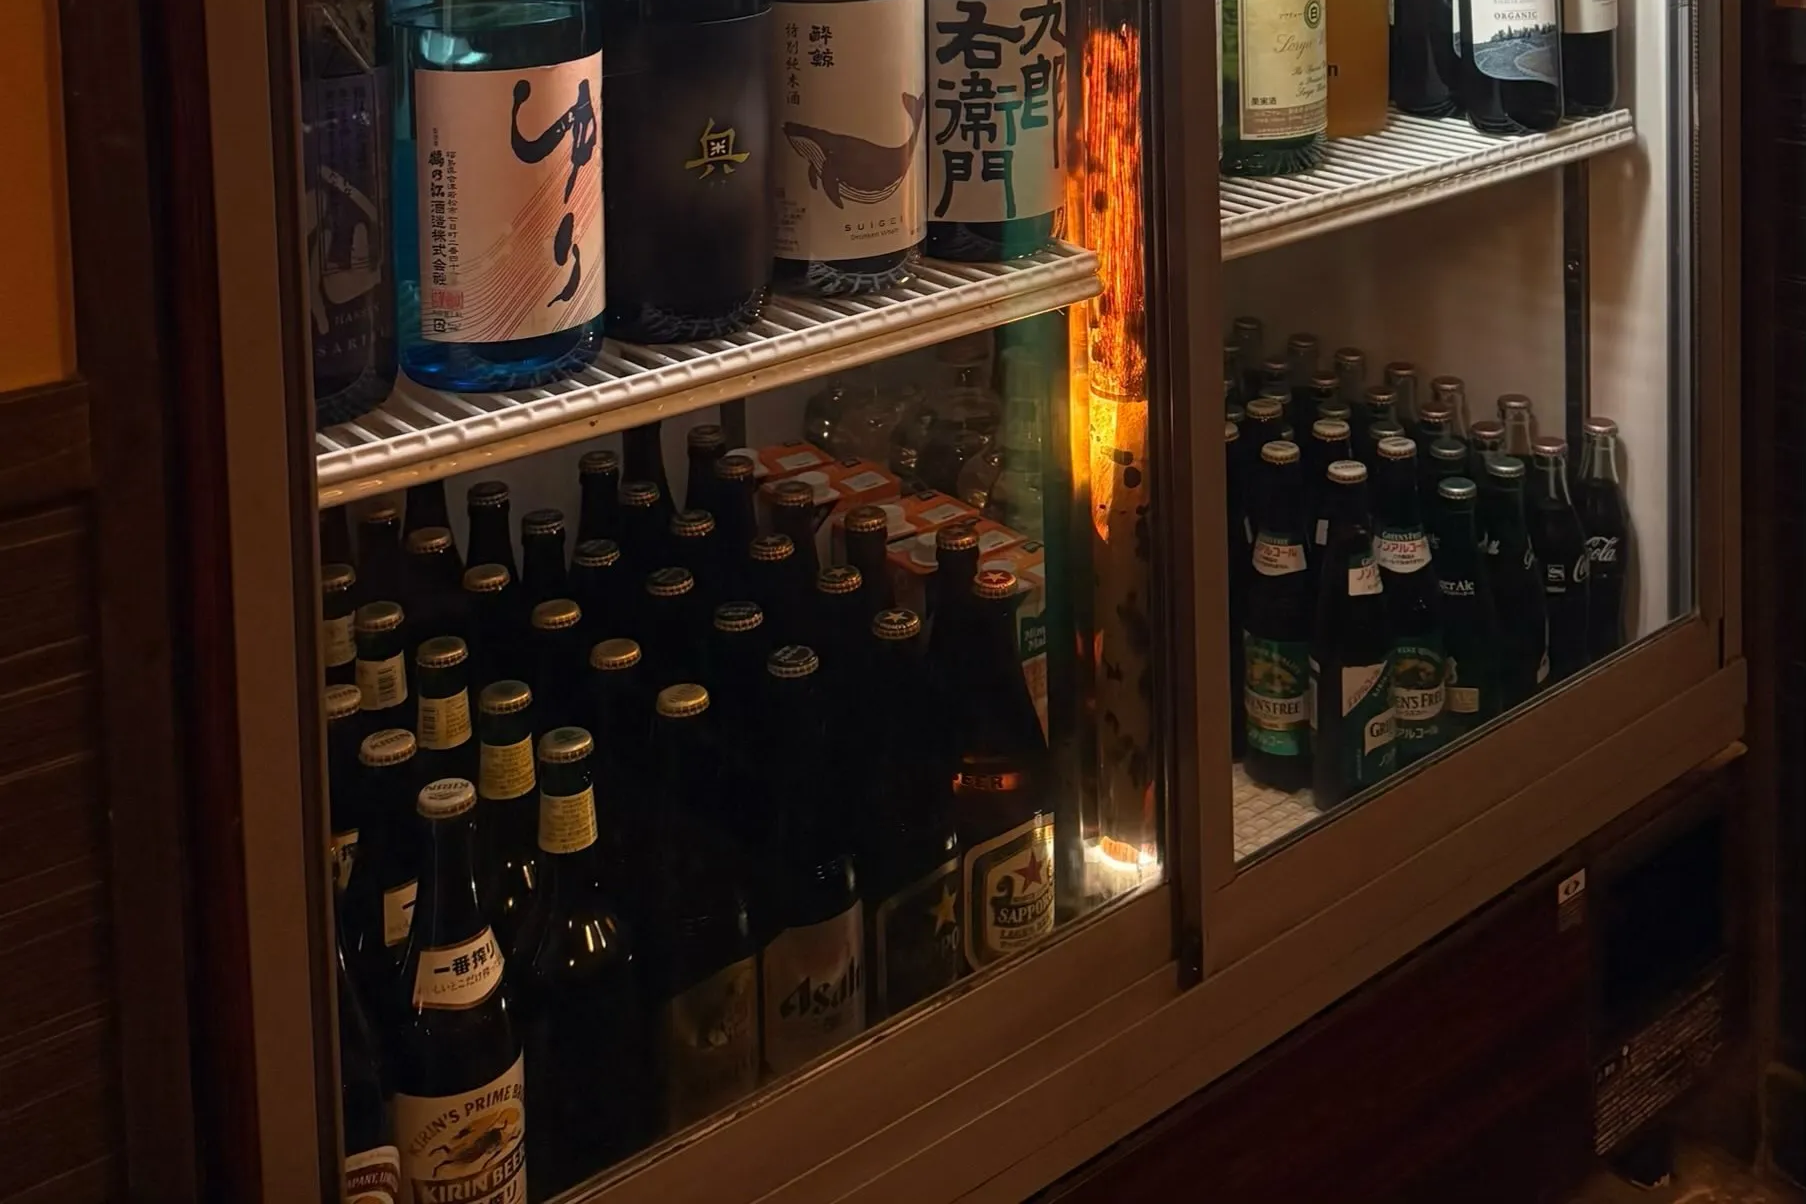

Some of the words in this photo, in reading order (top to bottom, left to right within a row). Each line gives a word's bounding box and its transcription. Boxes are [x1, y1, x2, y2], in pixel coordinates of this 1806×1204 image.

[1493, 11, 1538, 21] ORGANIC
[809, 24, 835, 69] 酔鯨
[433, 939, 495, 976] 一番搾り
[408, 1109, 461, 1156] KIRIN'S
[464, 1085, 512, 1117] PRIME
[423, 1177, 491, 1203] KIRIN
